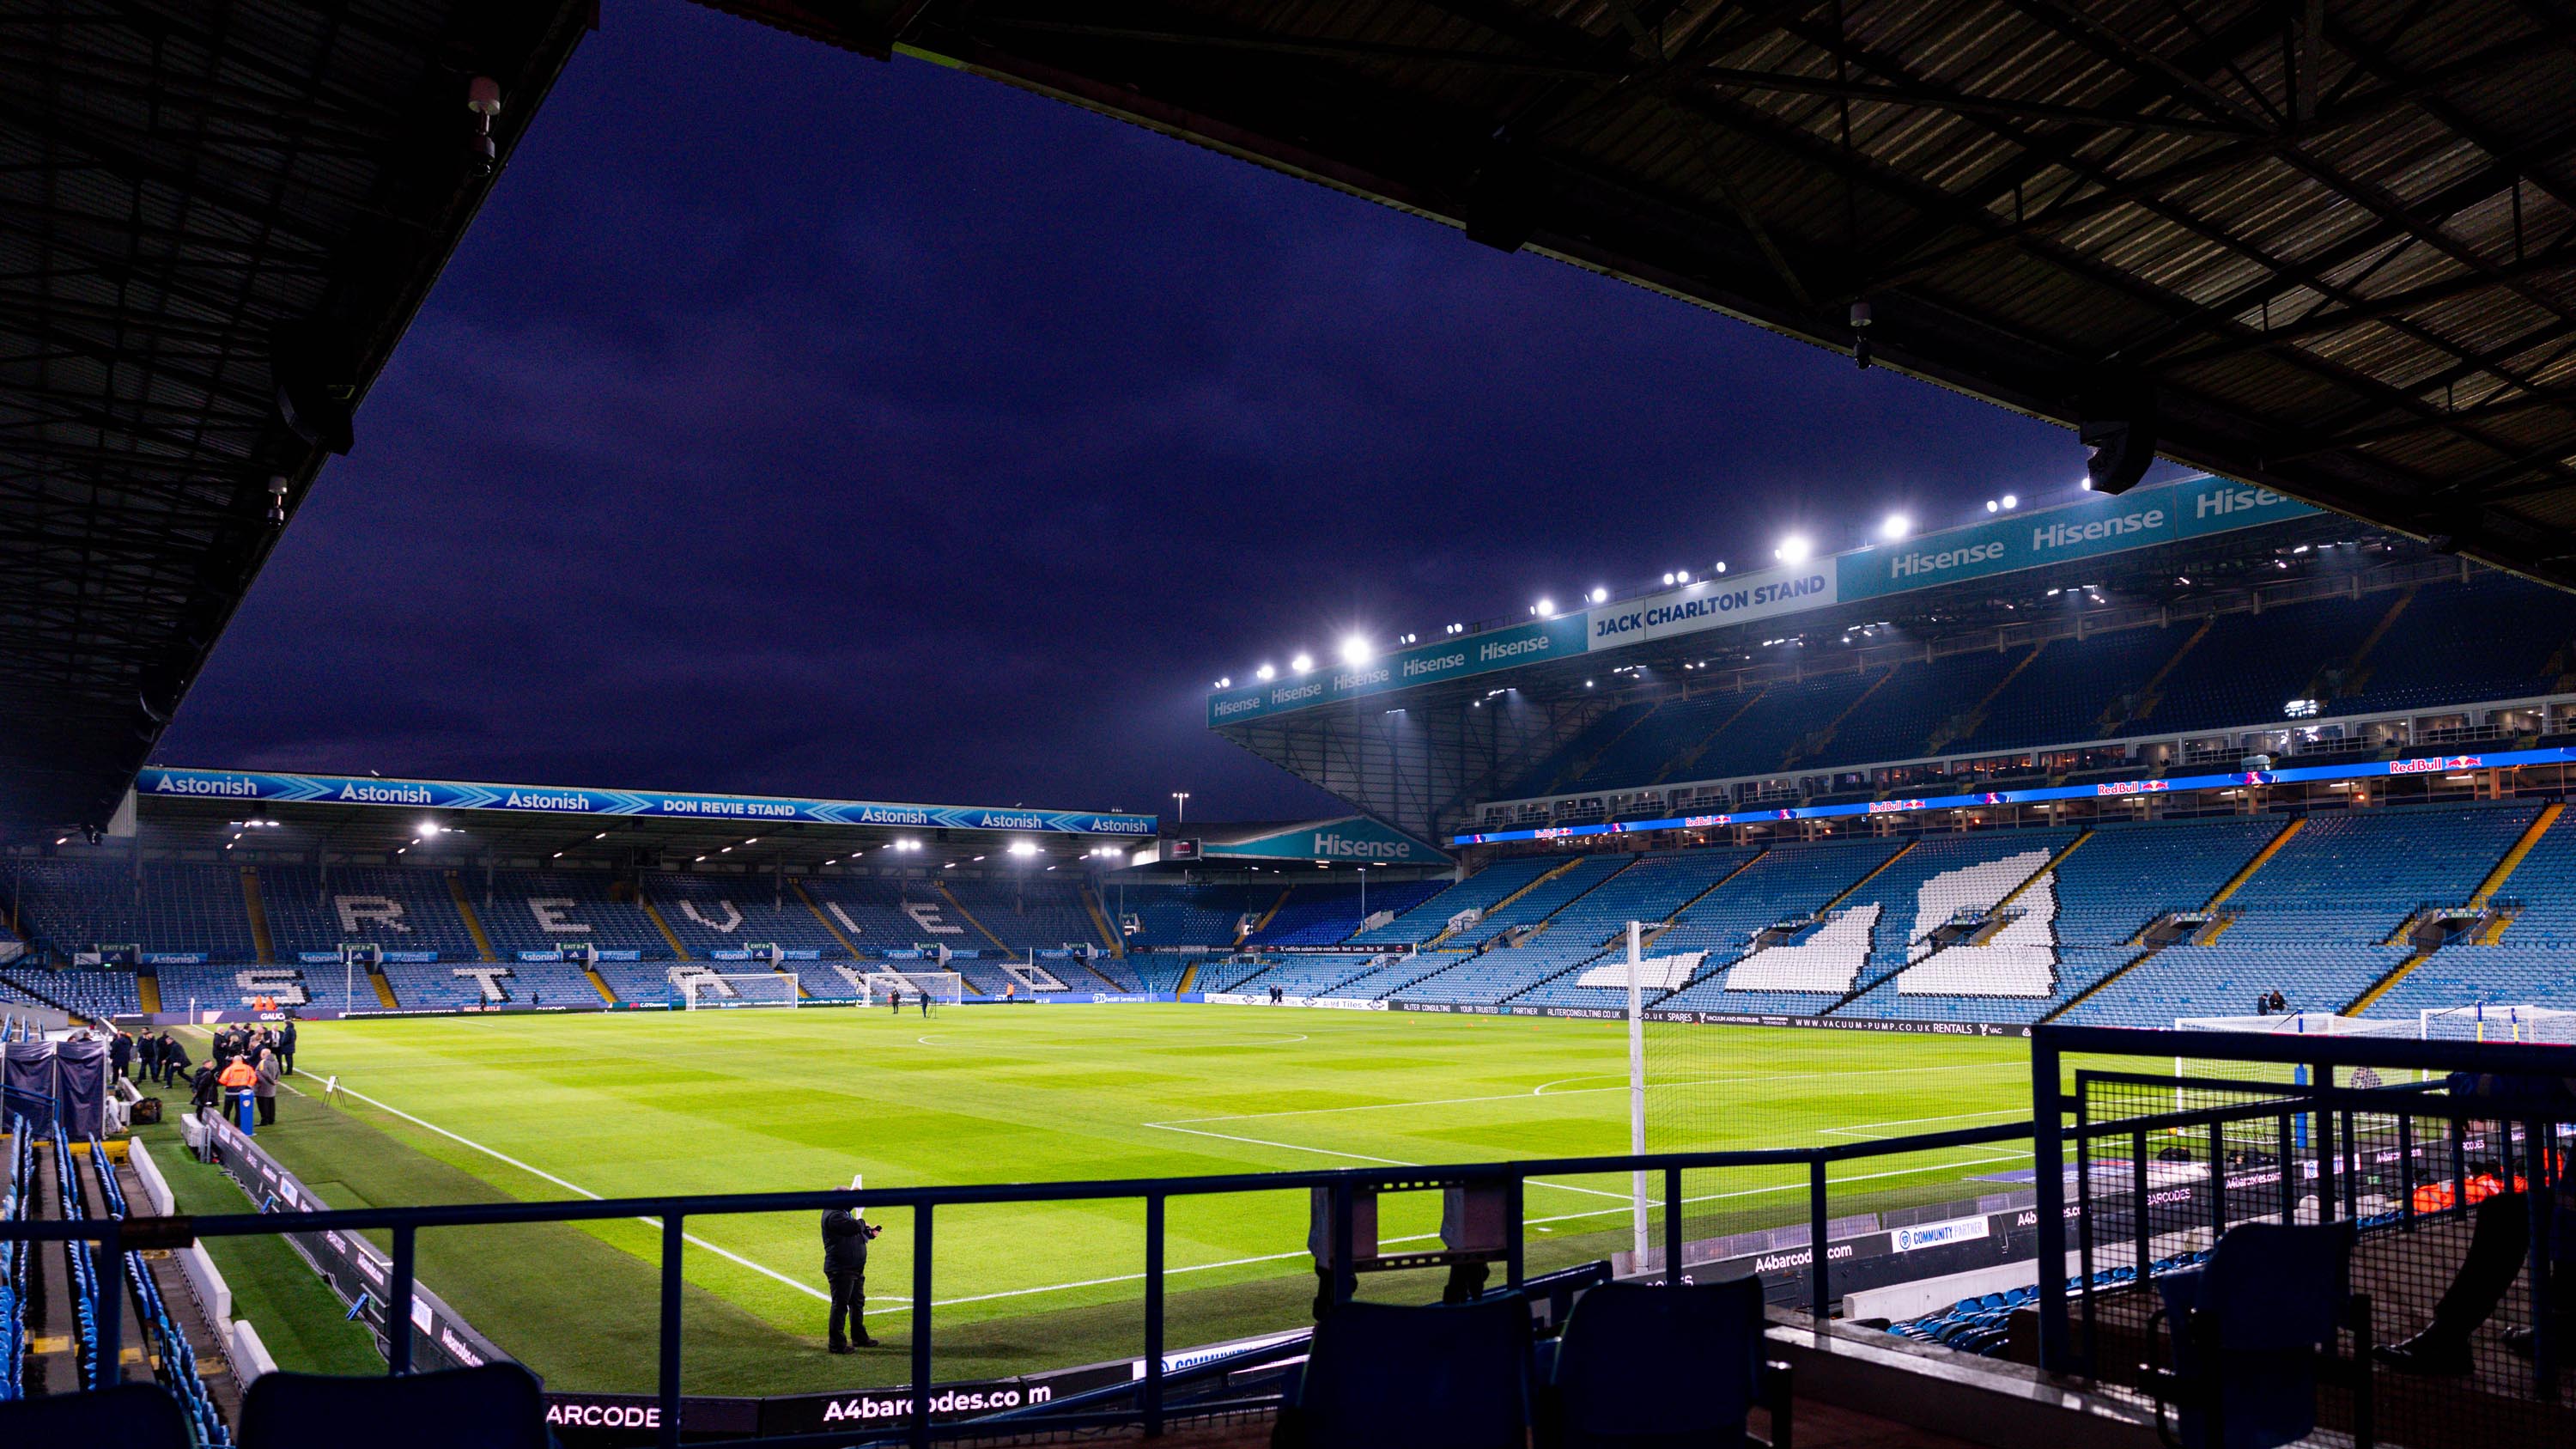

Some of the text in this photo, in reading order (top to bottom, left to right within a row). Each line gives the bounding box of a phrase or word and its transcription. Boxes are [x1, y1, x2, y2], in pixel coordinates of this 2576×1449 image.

[2196, 488, 2287, 520] Hise
[2033, 509, 2164, 551] Hisense
[1892, 541, 2004, 579] Hisense
[1596, 575, 1826, 636] JACK CHARLTON STAND
[1479, 635, 1549, 662] Hisense
[1402, 652, 1465, 678] Hisense
[1334, 669, 1389, 691] Hisense
[1272, 684, 1321, 704] Hisense
[1214, 696, 1261, 717] Hisense
[2390, 757, 2442, 773] Red Bull
[155, 773, 257, 795] Astonish
[339, 782, 432, 804] Astonish
[2098, 782, 2139, 796] Red Bull
[506, 789, 589, 811] Astonish
[663, 800, 796, 817] DON REVIE STAND
[1869, 801, 1902, 813] Red Bull
[861, 806, 927, 825] Astonish
[981, 811, 1042, 830] Astonish
[1091, 815, 1148, 833] Astonish
[1686, 815, 1711, 827] Red Bull
[1534, 828, 1557, 838] Red Bull
[1314, 832, 1410, 858] Hisense
[151, 954, 199, 964] Astonish
[301, 953, 340, 963] Astonish
[521, 953, 558, 961] Astonish
[1547, 1008, 1620, 1019] ALITERCONSULTING.CO.UK
[1668, 1014, 1692, 1022] SPARES
[1795, 1018, 1972, 1034] WWW.VACUUM-PUMP.CO.UK RENTALS
[1990, 1026, 2002, 1035] VAC
[1913, 1221, 1983, 1245] COMMUNITY PARTNER
[1755, 1245, 1853, 1273] A4barcod.com
[546, 1405, 662, 1428] ARCODE
